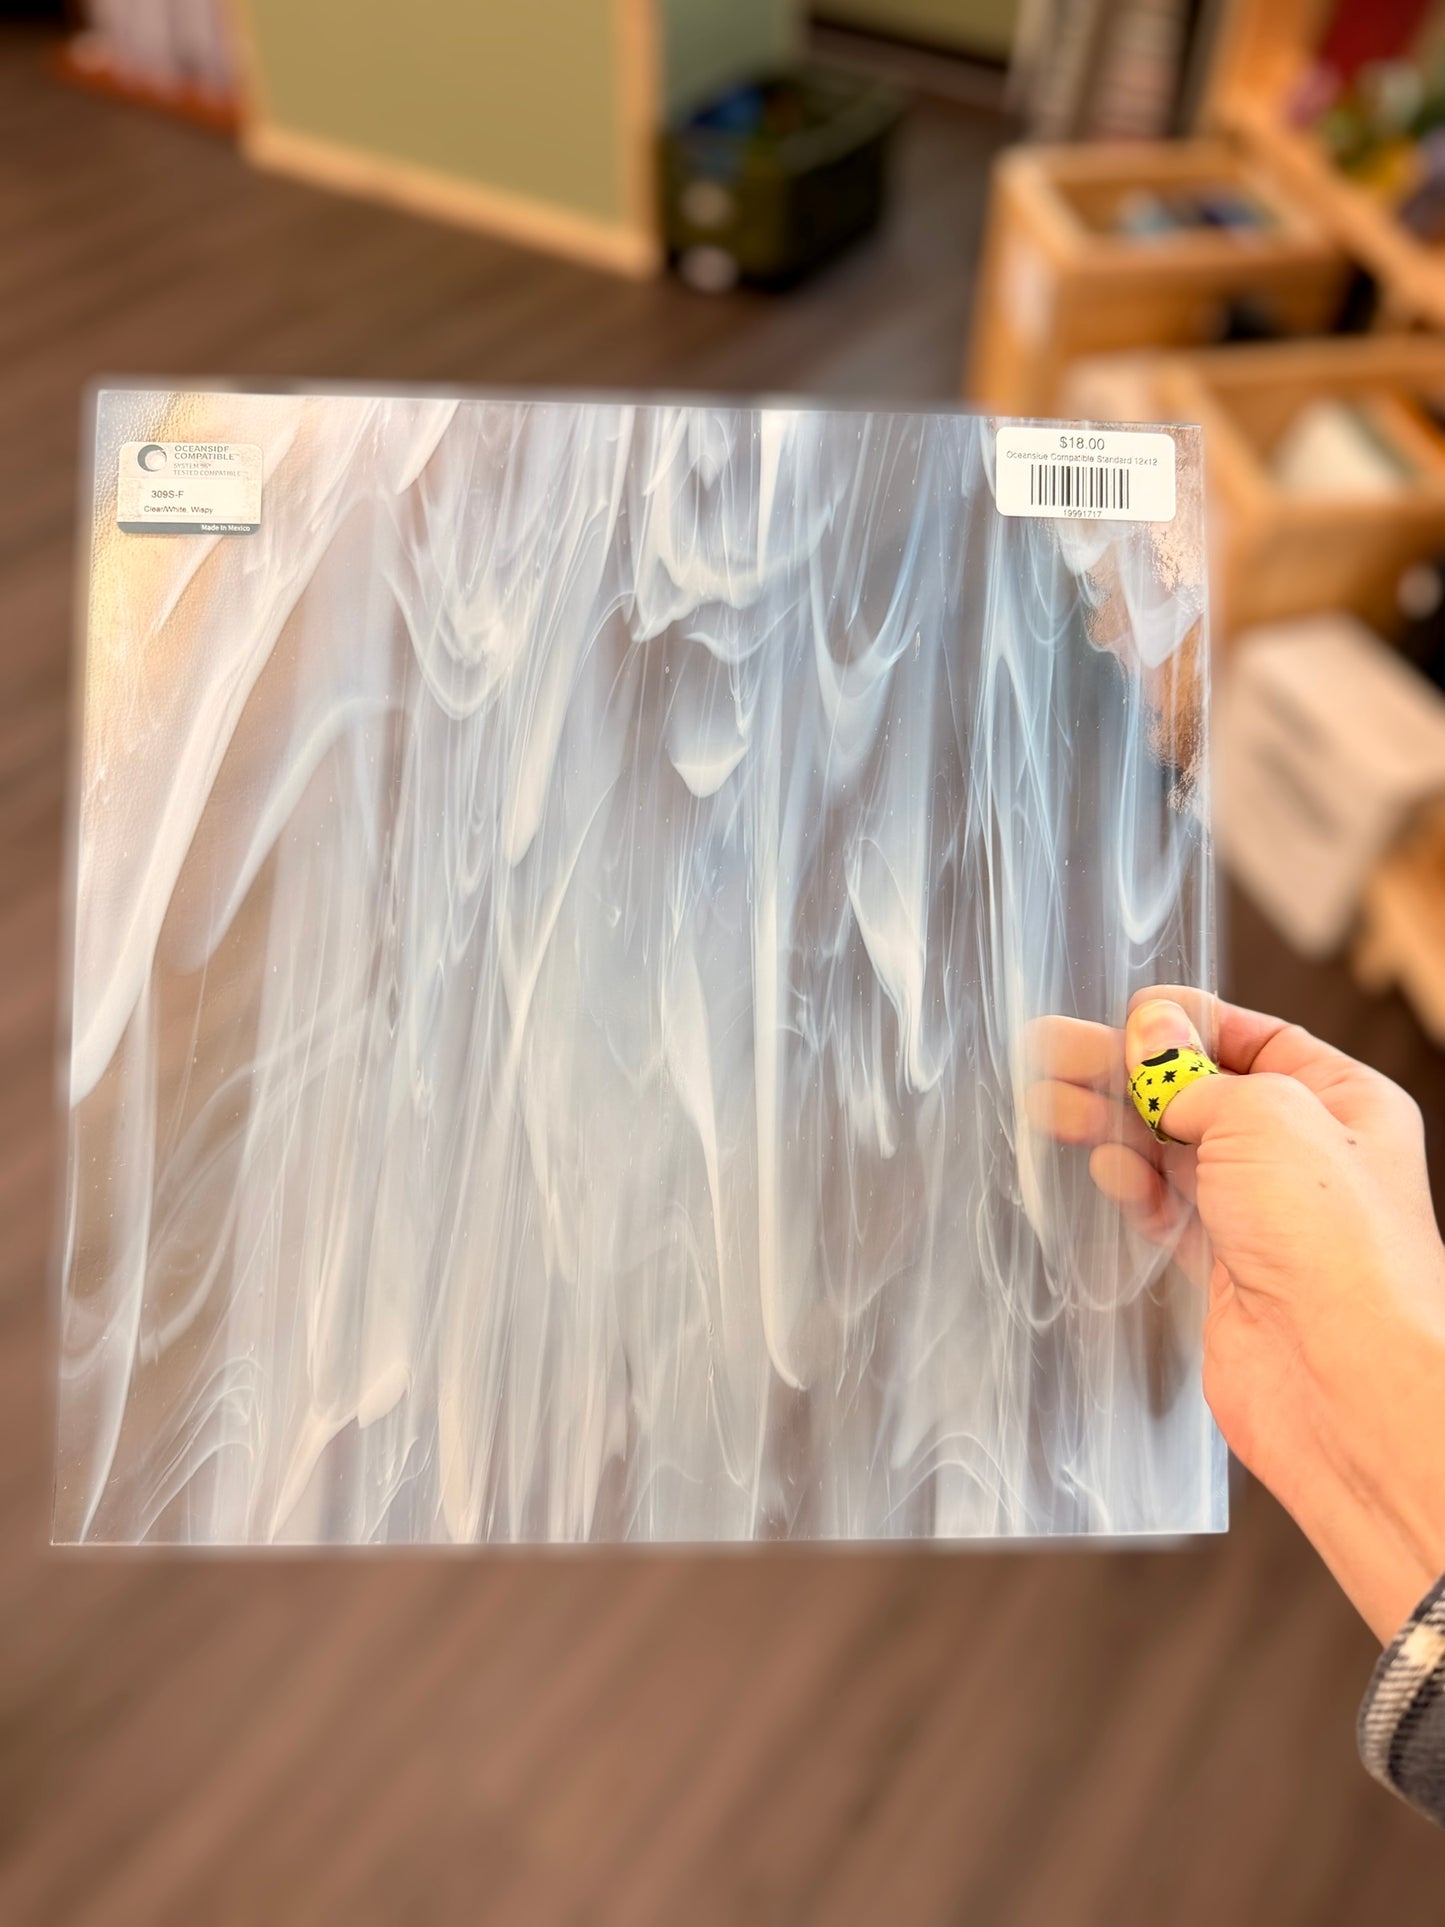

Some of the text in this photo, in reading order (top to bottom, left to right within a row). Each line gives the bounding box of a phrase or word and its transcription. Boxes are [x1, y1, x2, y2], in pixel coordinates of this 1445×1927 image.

[1059, 436, 1105, 451] $18.00
[1050, 452, 1094, 463] Compatible
[1096, 455, 1132, 465] Standard
[1134, 457, 1158, 466] 12x12
[151, 490, 184, 499] 309S-F
[190, 506, 214, 514] Wispy
[1063, 509, 1102, 518] 19991717
[228, 524, 251, 532] Mexico
